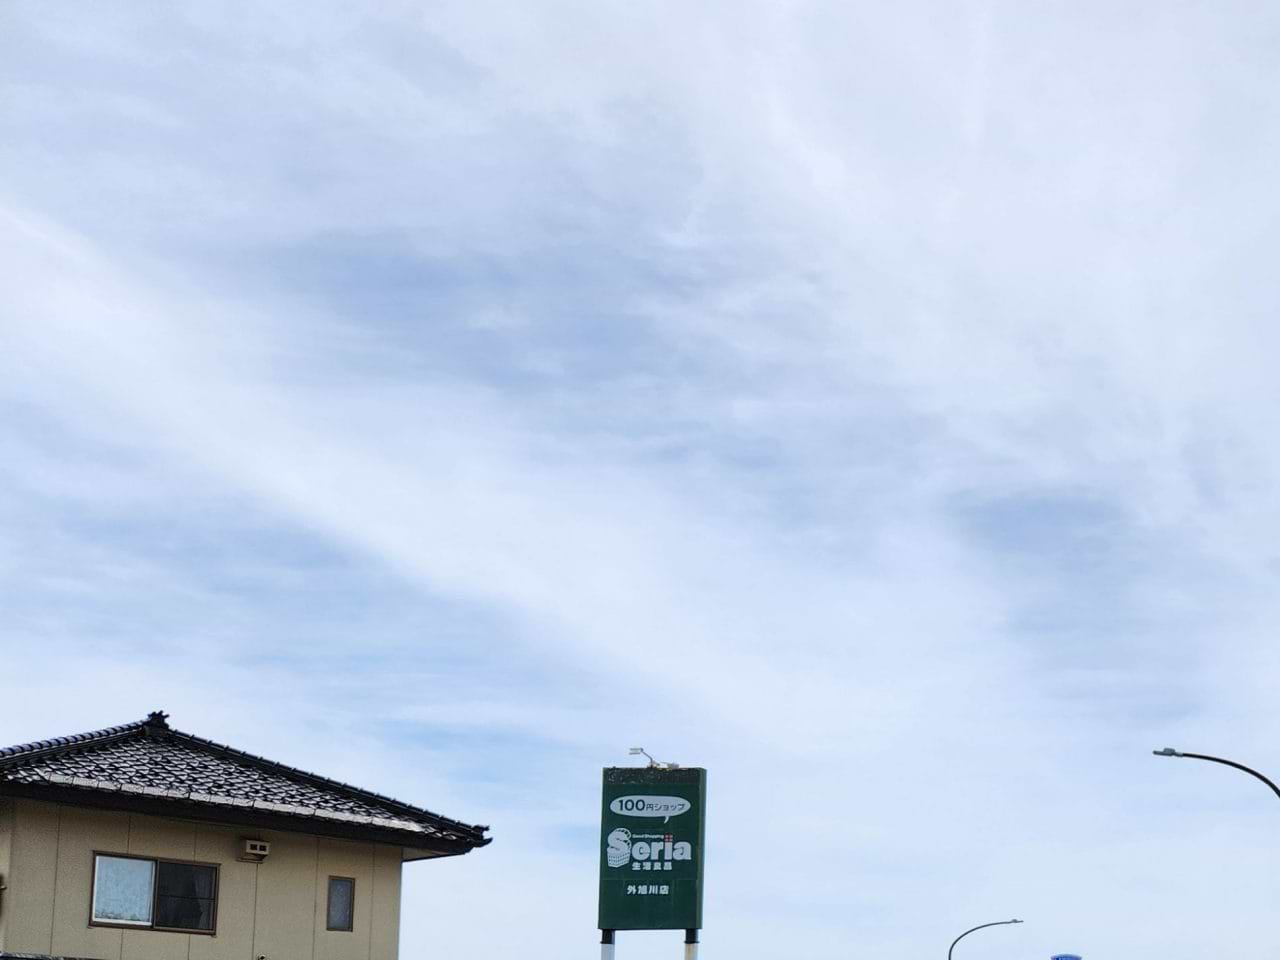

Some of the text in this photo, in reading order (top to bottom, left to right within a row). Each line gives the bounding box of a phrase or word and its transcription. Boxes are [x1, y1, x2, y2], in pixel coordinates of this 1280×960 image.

[618, 799, 685, 812] 100円ショップ
[607, 827, 692, 868] Seria
[627, 885, 669, 895] 外旭川店
